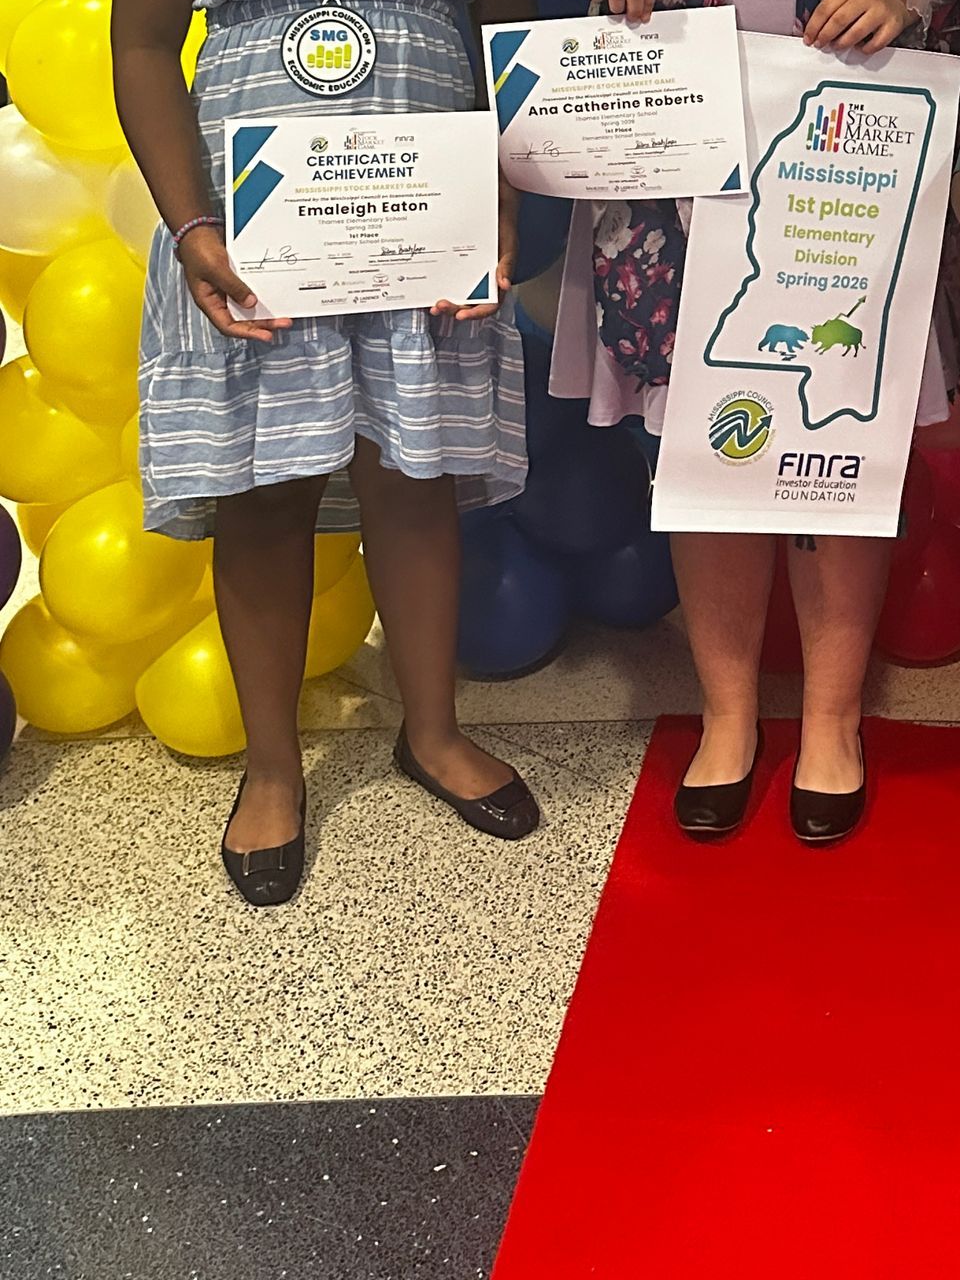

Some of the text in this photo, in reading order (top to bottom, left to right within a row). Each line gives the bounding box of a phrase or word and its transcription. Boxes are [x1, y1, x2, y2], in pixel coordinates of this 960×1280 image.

[289, 11, 371, 45] MISSISSIPPI COUNCIL ON
[310, 30, 348, 41] SMG
[560, 50, 664, 67] CERTIFICATE OF
[288, 60, 370, 91] ECONOMIC EDUCATION
[566, 64, 661, 80] ACHIEVEMENT
[552, 85, 595, 93] MISSISSIPPI
[528, 94, 704, 116] Ana Catherine Roberts
[849, 103, 864, 111] THE
[847, 110, 898, 129] STOCK
[844, 121, 915, 144] MARKET
[307, 153, 419, 166] CERTIFICATE OF
[312, 167, 414, 181] ACHIEVEMENT
[778, 161, 898, 193] Mississippi
[299, 202, 428, 217] Emaleigh Eaton
[787, 194, 879, 220] 1st place
[783, 225, 875, 248] Elementary
[795, 249, 857, 266] Division
[776, 272, 868, 291] Spring 2026
[708, 390, 774, 422] MISSISSIPPI COUNCIL
[776, 479, 857, 489] Investor Education
[775, 490, 856, 502] FOUNDATION
